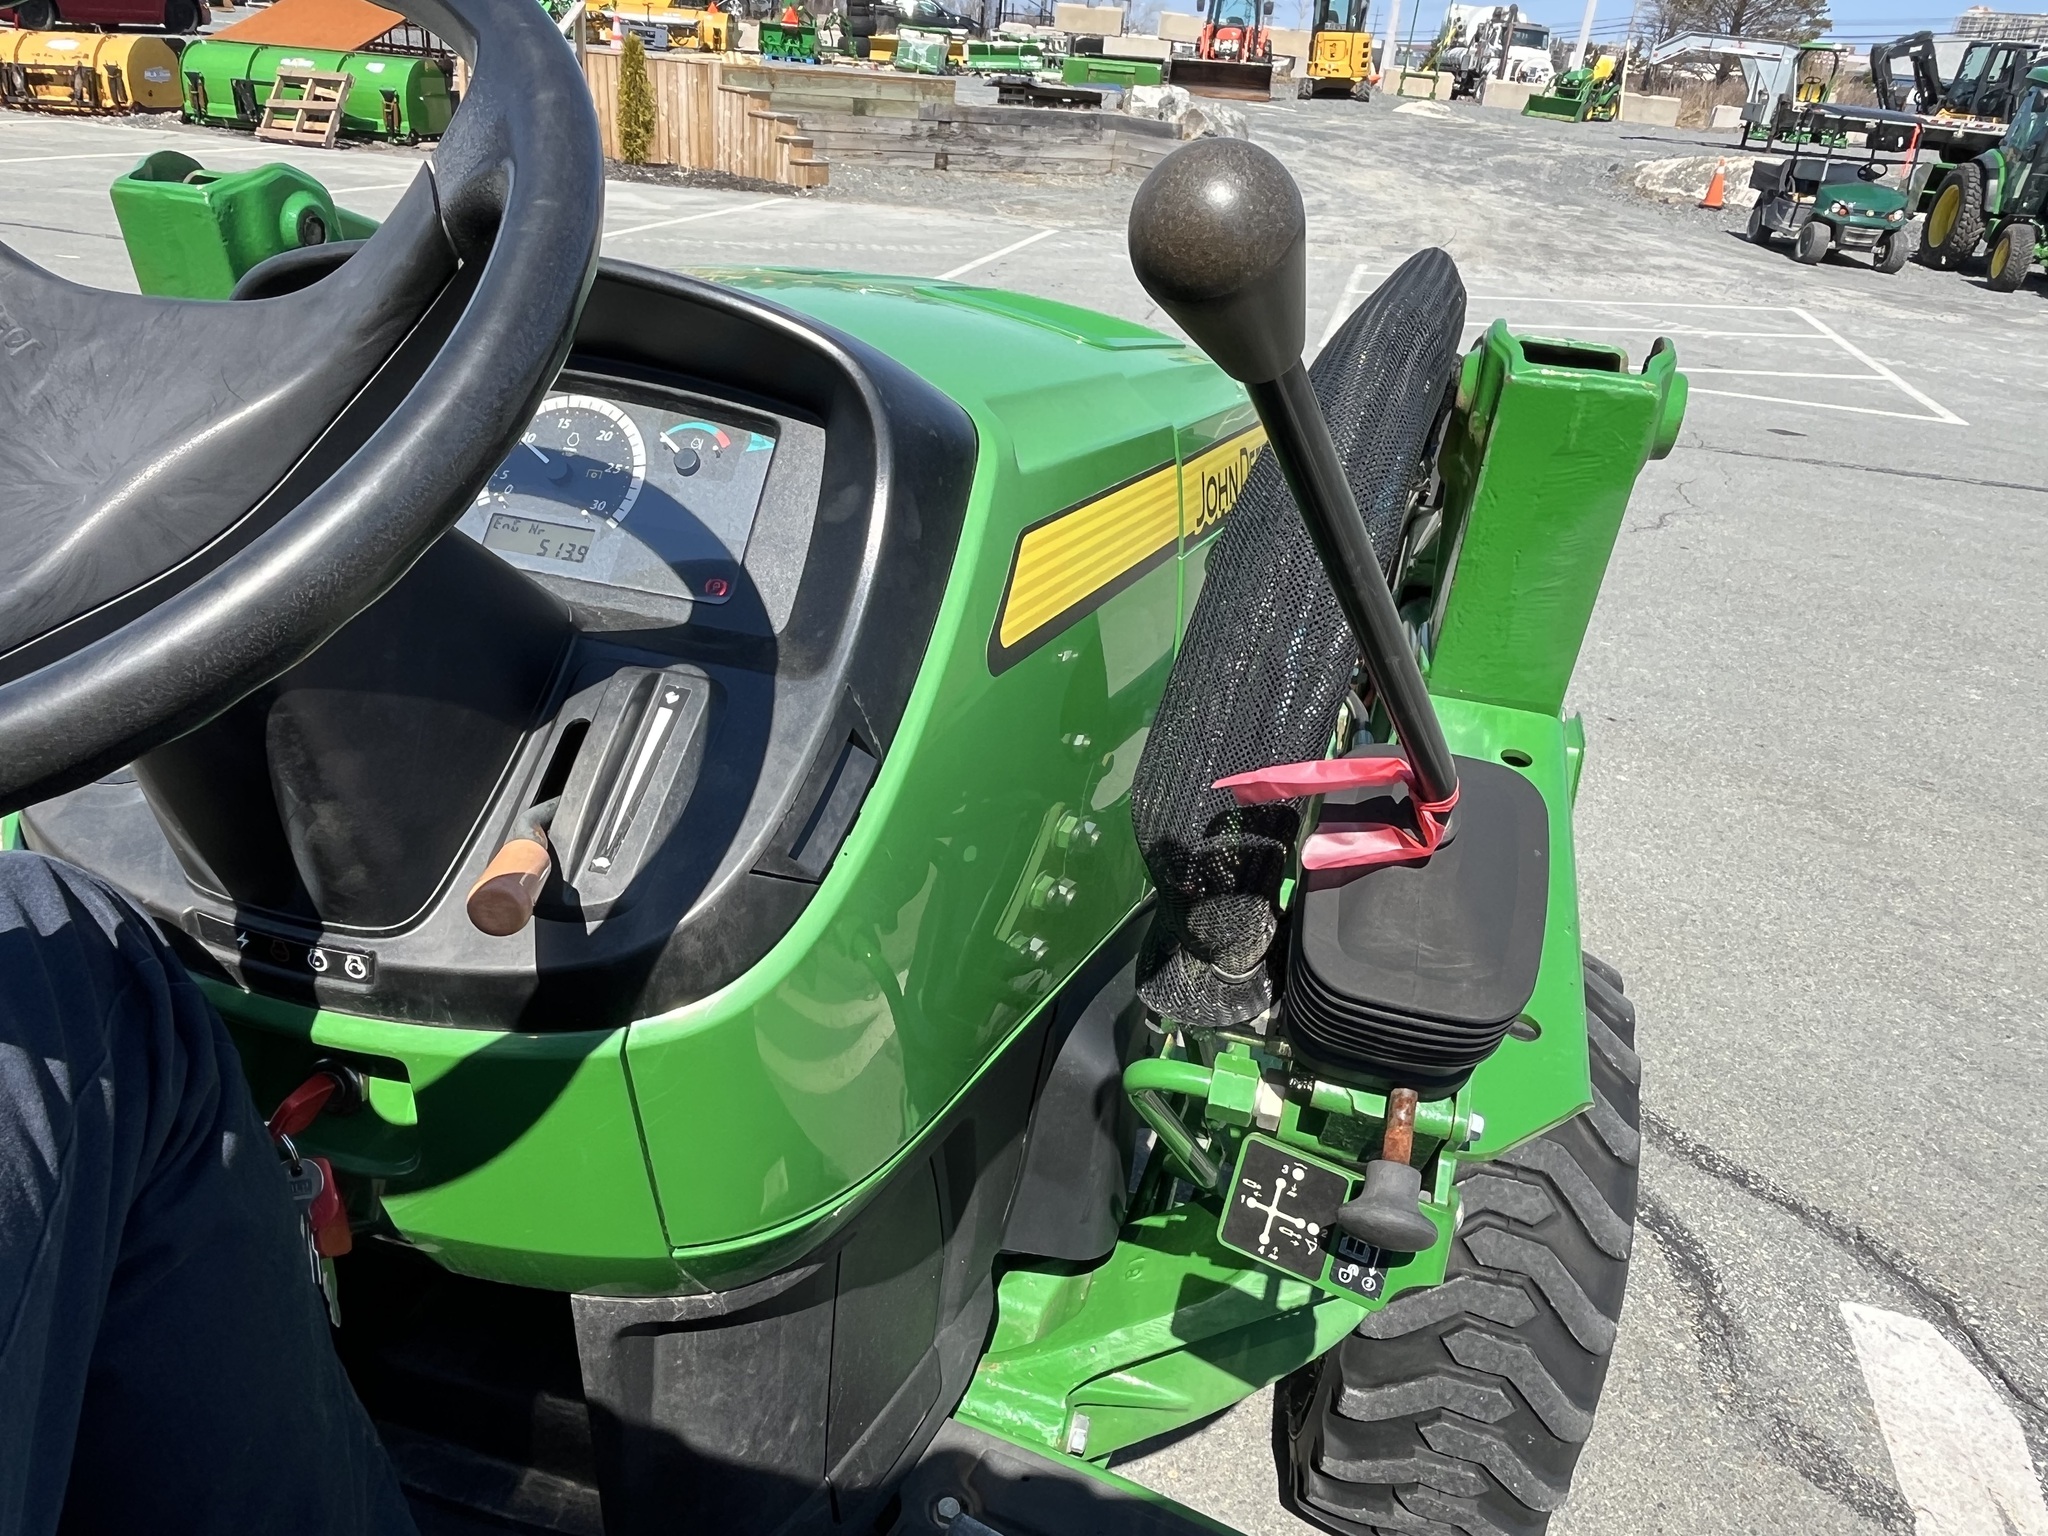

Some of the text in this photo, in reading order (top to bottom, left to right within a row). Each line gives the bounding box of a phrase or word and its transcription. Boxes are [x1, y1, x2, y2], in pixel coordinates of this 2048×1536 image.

[557, 418, 572, 429] 15
[595, 430, 614, 442] 20
[604, 462, 623, 474] 25
[499, 470, 510, 480] 5
[504, 484, 514, 494] 0
[1196, 461, 1240, 528] JOHN
[589, 499, 607, 511] 30
[1281, 1164, 1289, 1174] 3
[1241, 1194, 1246, 1203] 1
[1321, 1230, 1329, 1238] 2
[1257, 1245, 1266, 1254] 4
